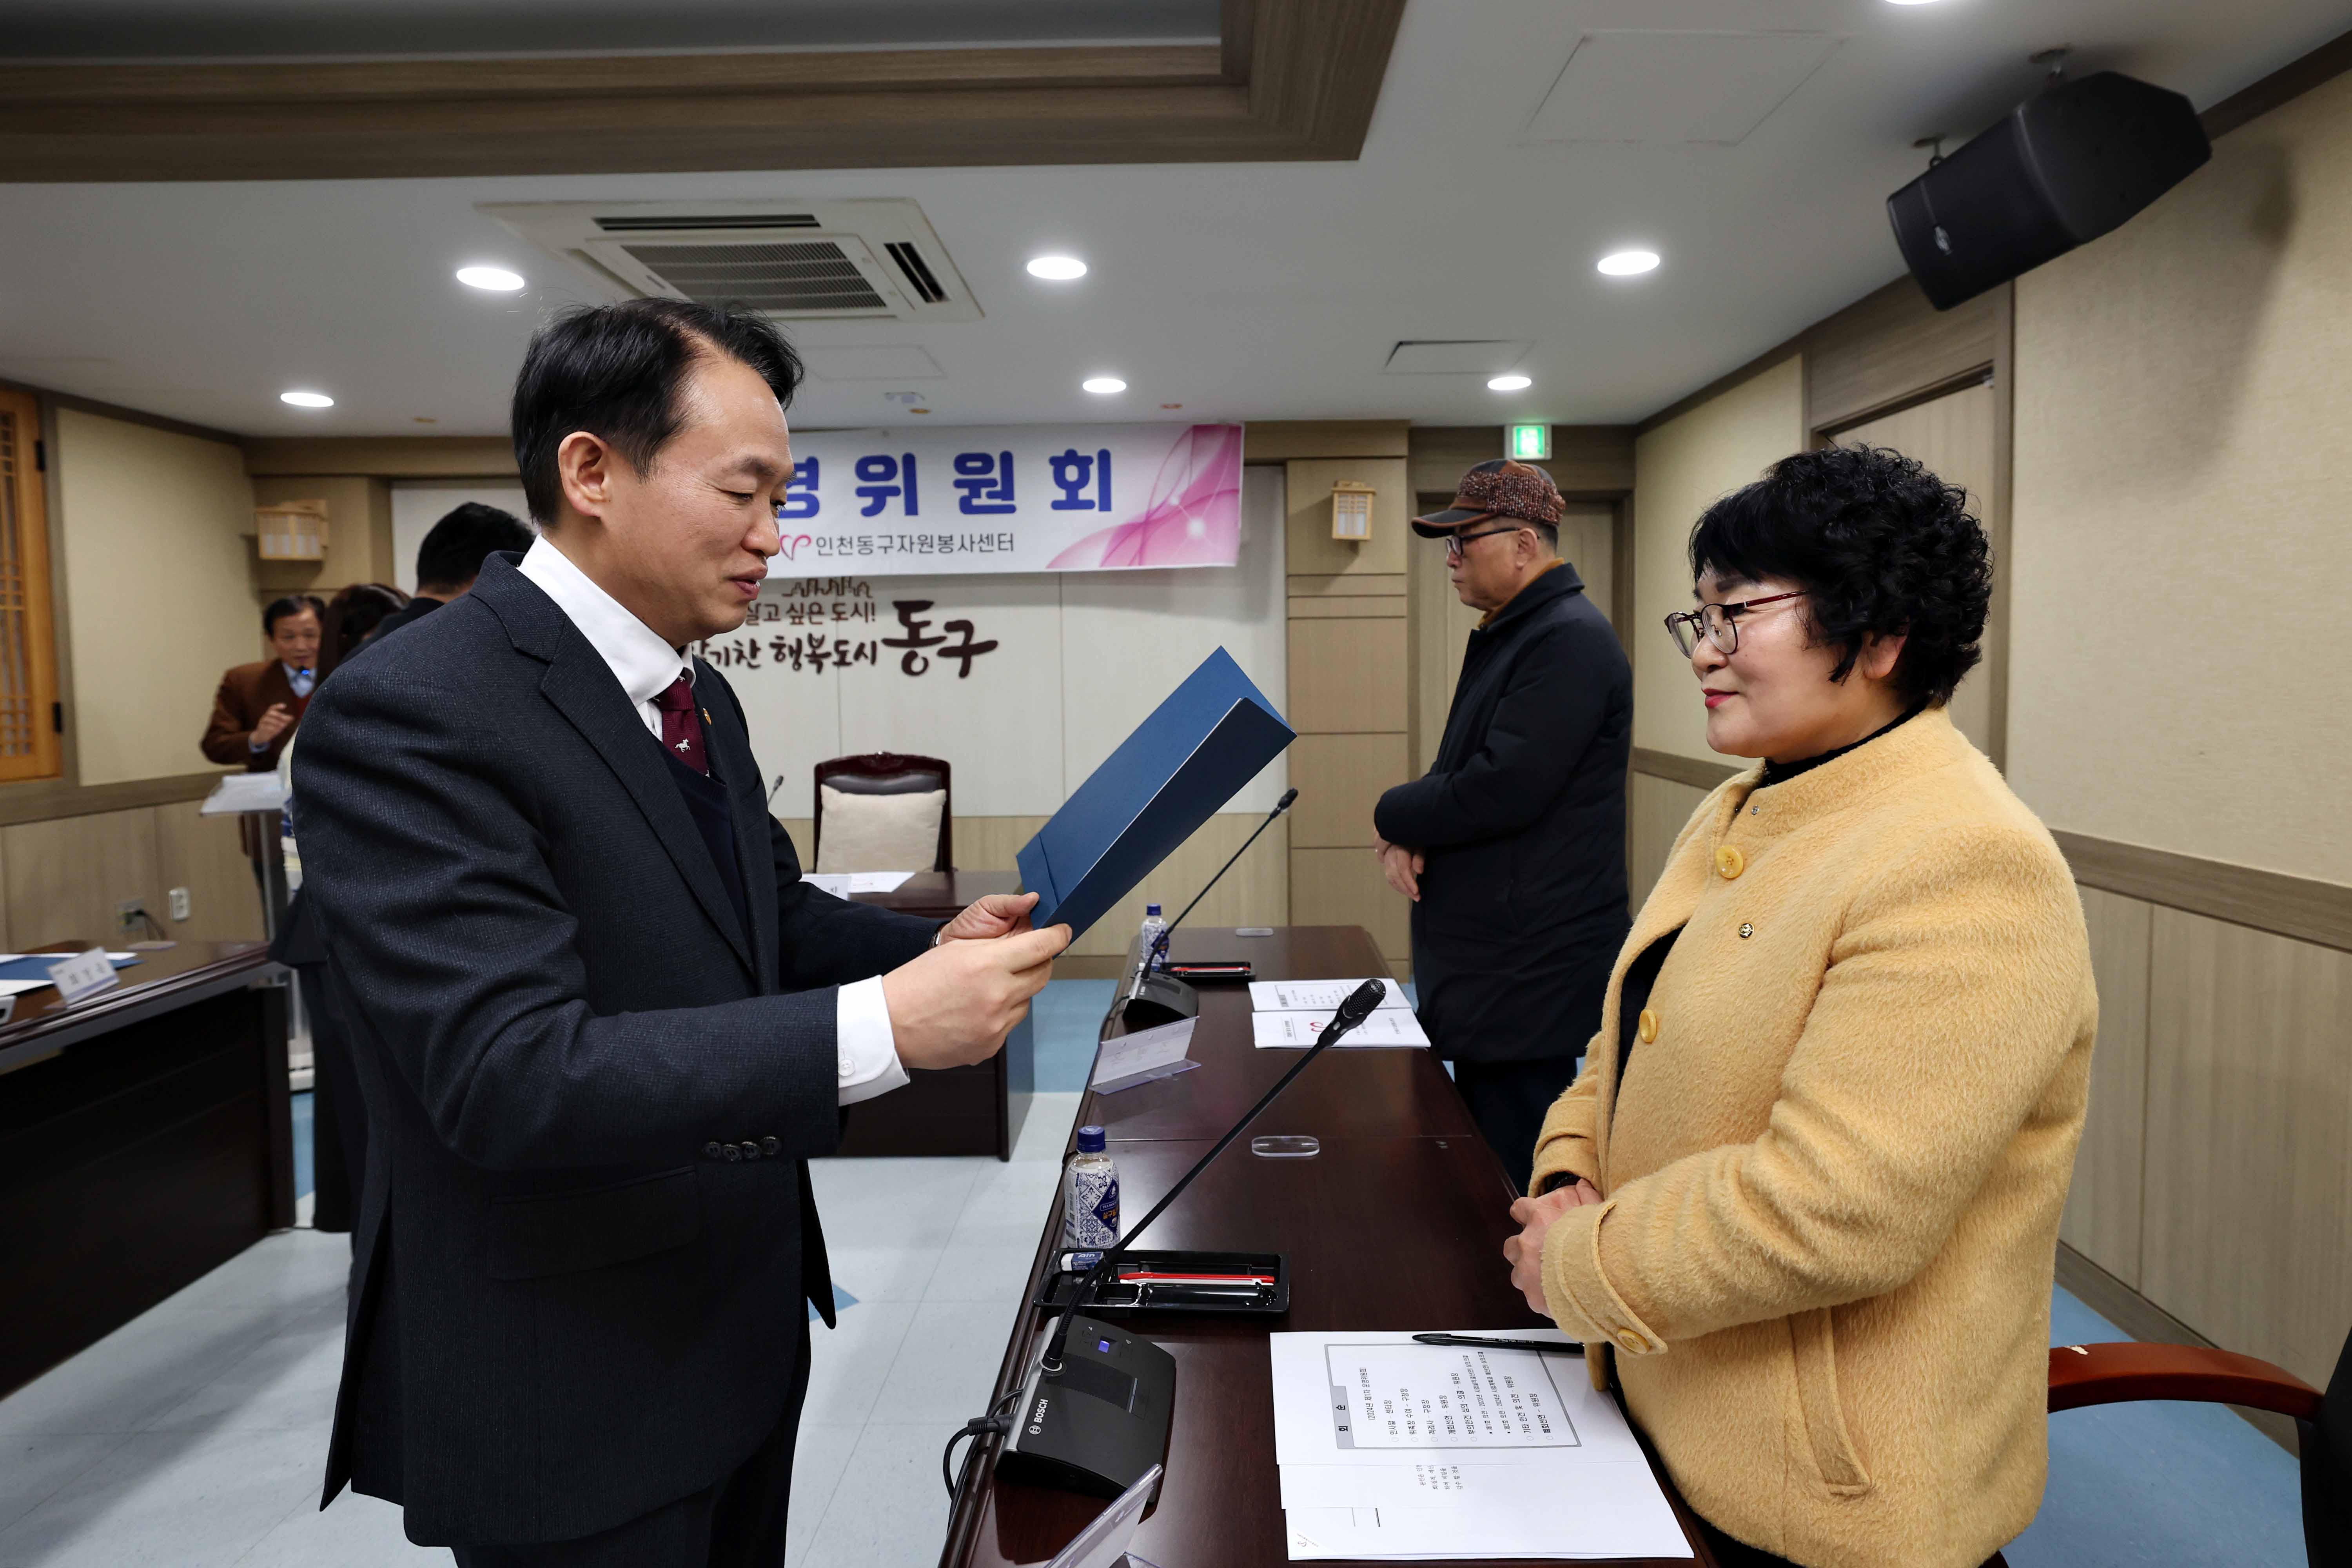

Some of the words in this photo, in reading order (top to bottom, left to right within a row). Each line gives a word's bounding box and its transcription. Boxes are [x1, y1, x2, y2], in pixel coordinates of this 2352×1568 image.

[815, 533, 1014, 557] 인천동구자원봉사센터
[745, 603, 780, 625] 살고
[786, 602, 824, 625] 싶은
[831, 602, 875, 622] 도시!
[769, 632, 877, 674] 행복도시
[881, 600, 998, 679] 동구
[1359, 1367, 1370, 1387] 운영위원회)
[1451, 1373, 1461, 1385] 위원장
[1504, 1376, 1515, 1388] 위원장
[1400, 1388, 1410, 1401] 구청장
[1439, 1395, 1449, 1408] 위원장
[1456, 1390, 1465, 1399] 의결
[1493, 1394, 1502, 1406] 2024년
[1511, 1394, 1520, 1403] 의견
[1529, 1393, 1540, 1407] 위원장
[1033, 1399, 1049, 1423] BOSCH
[1365, 1403, 1375, 1420] (2024년
[1384, 1400, 1393, 1414] 센터장
[1405, 1409, 1414, 1418] 수여
[1421, 1400, 1431, 1414] 구청장
[1460, 1404, 1470, 1413] 심의
[1517, 1412, 1527, 1421] 안건
[1537, 1414, 1551, 1433] 폐회선언
[1387, 1421, 1397, 1435] 인사말
[1407, 1421, 1417, 1435] 위촉장
[1444, 1416, 1456, 1434] 개회선언
[1463, 1415, 1476, 1434] 부의안건
[1522, 1424, 1531, 1434] 기타
